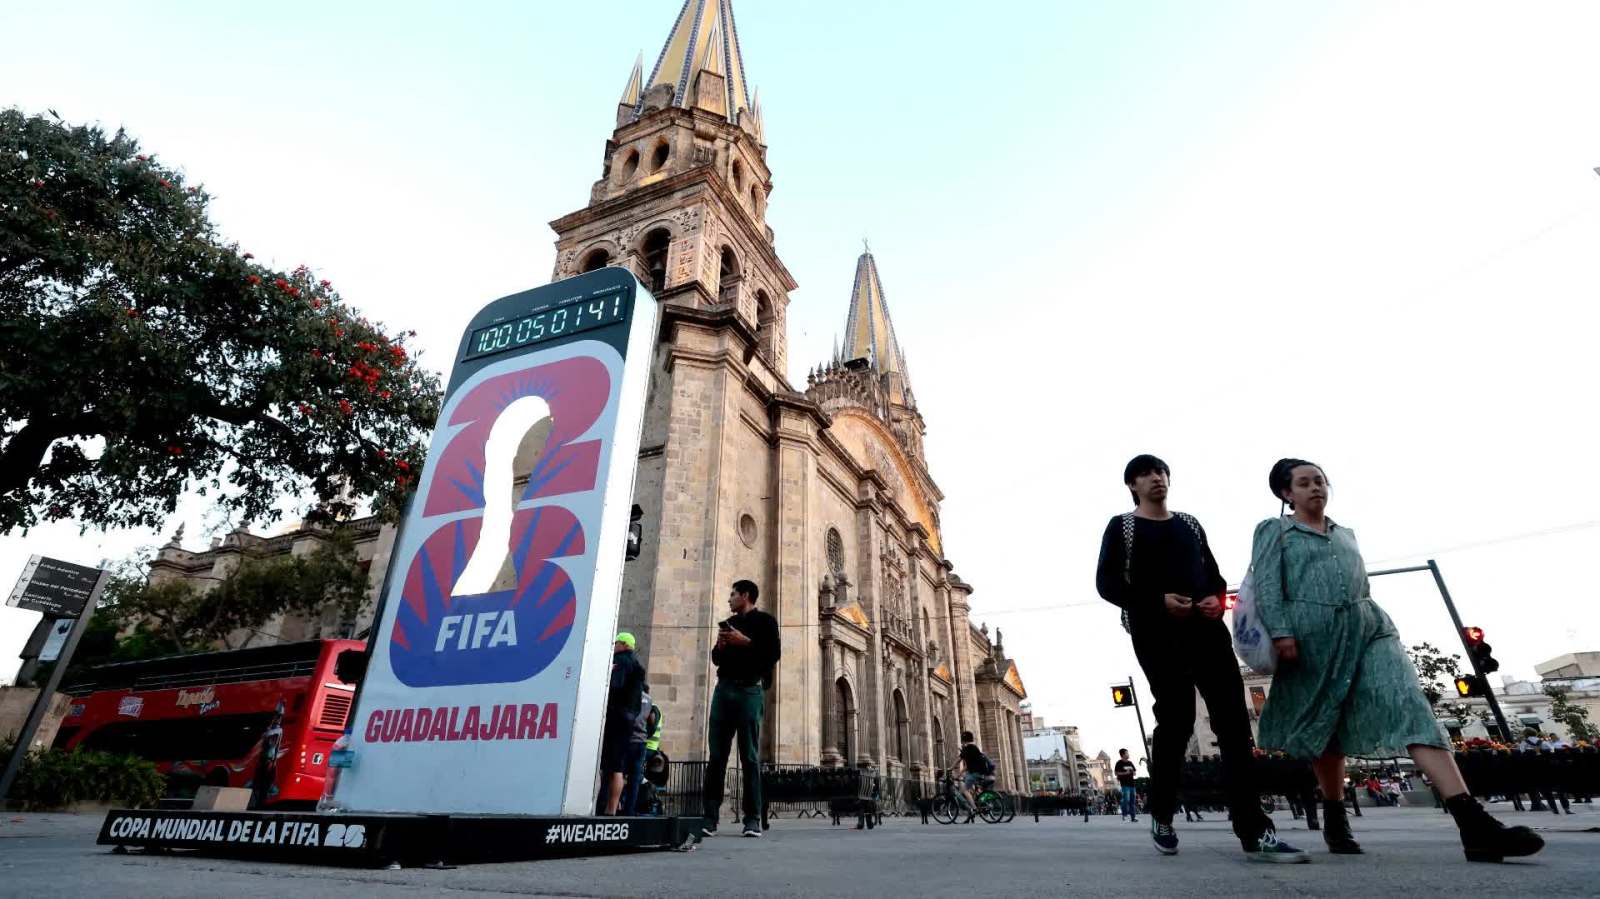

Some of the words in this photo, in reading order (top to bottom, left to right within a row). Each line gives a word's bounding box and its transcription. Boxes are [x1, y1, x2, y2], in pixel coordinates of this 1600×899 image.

[478, 324, 512, 352] 100
[516, 315, 545, 342] 05
[551, 306, 582, 334] 01
[589, 296, 620, 321] 41
[434, 610, 518, 652] FIFA
[364, 702, 559, 743] GUADALAJARA
[109, 816, 150, 839] COPA
[151, 817, 225, 842] MUNDIAL
[226, 820, 252, 843] DE
[252, 821, 277, 844] LA
[278, 821, 320, 846] FIFA
[324, 823, 366, 848] 26
[545, 823, 629, 844] #WEARE26
